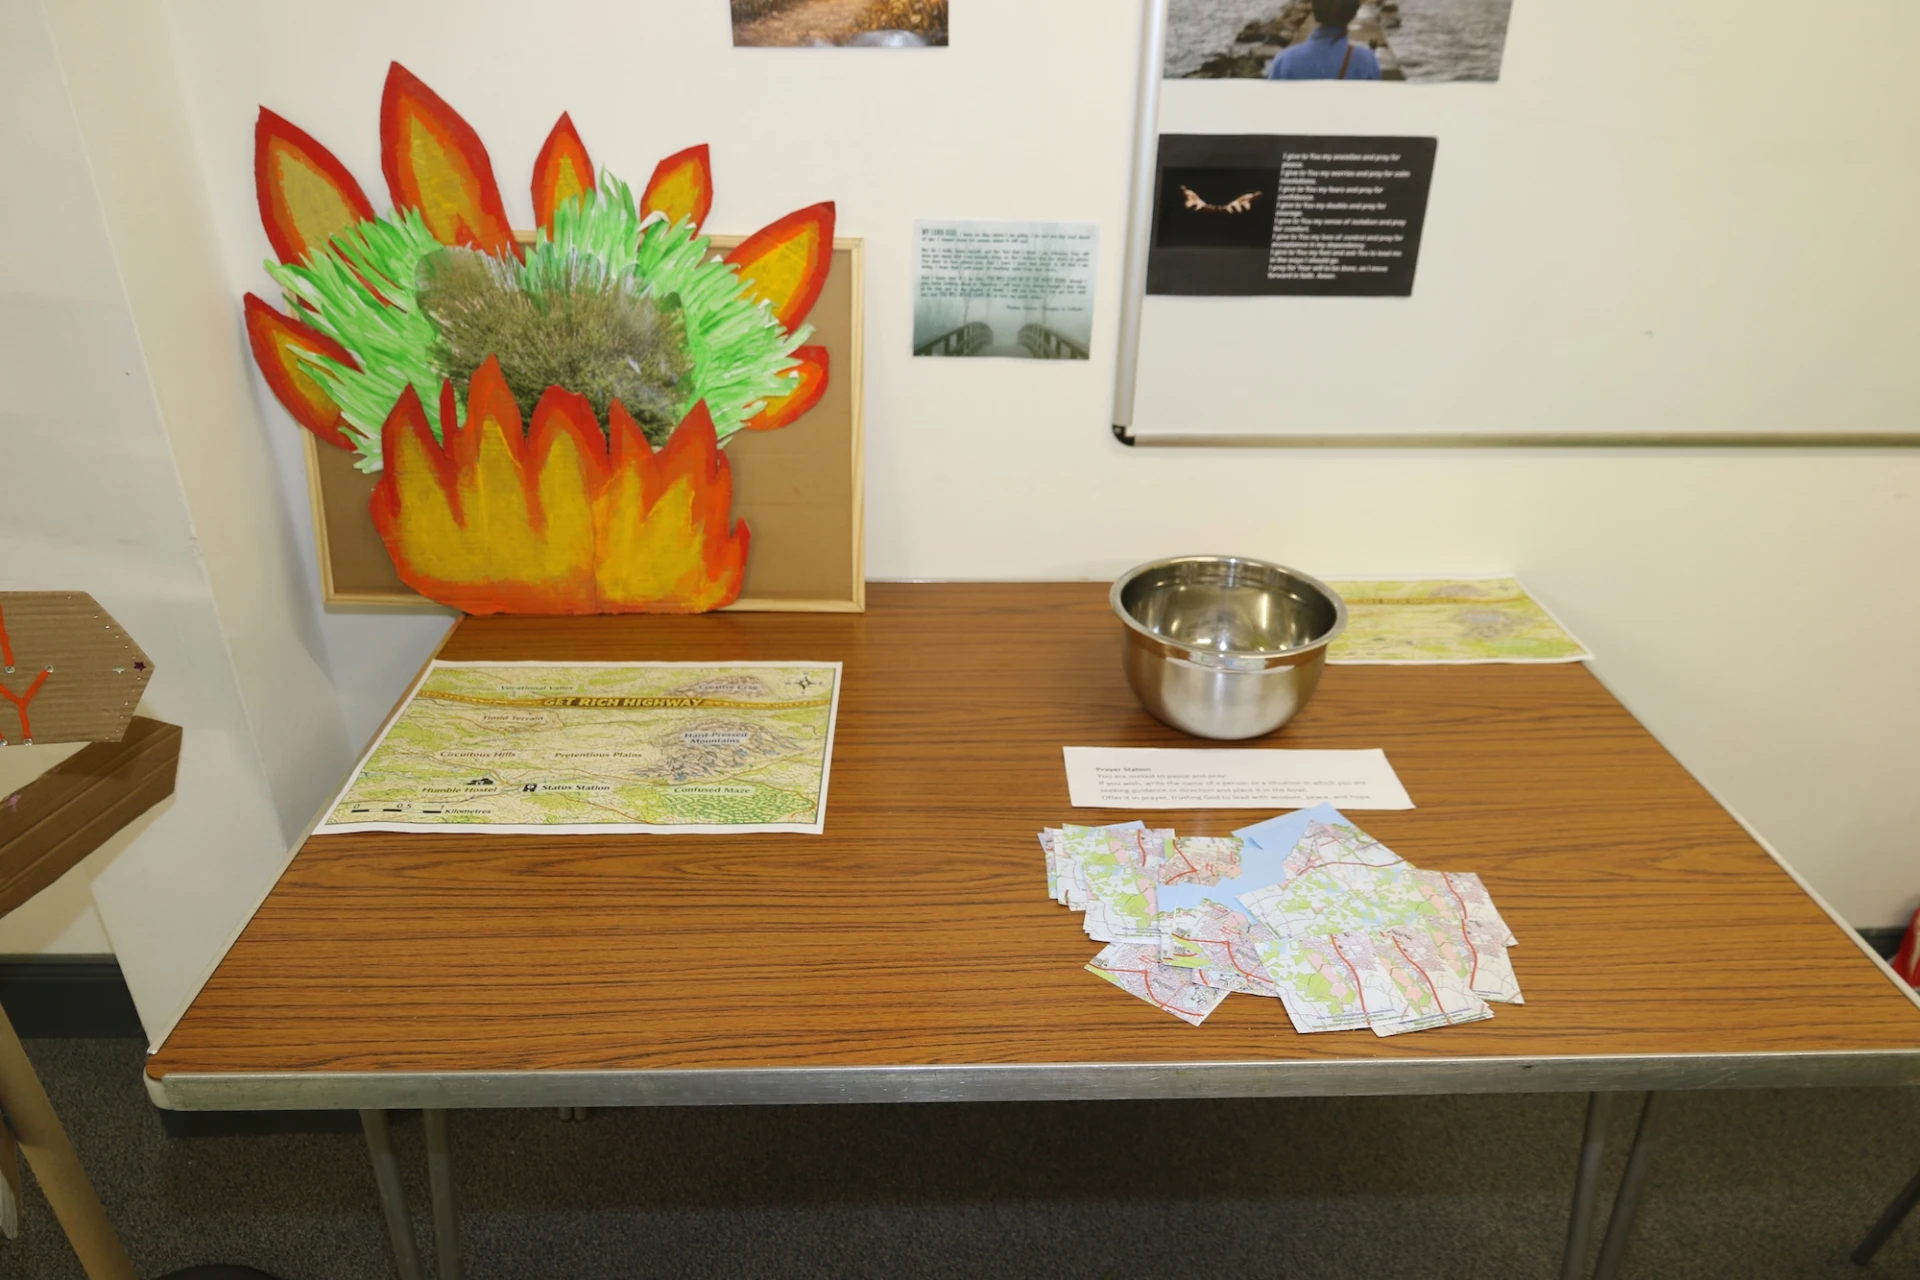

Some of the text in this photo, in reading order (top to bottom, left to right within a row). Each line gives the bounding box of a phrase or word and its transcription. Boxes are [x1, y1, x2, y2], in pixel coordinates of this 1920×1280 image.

[543, 698, 703, 707] GET RICH HIGHWAY
[674, 786, 751, 794] Confused Maze
